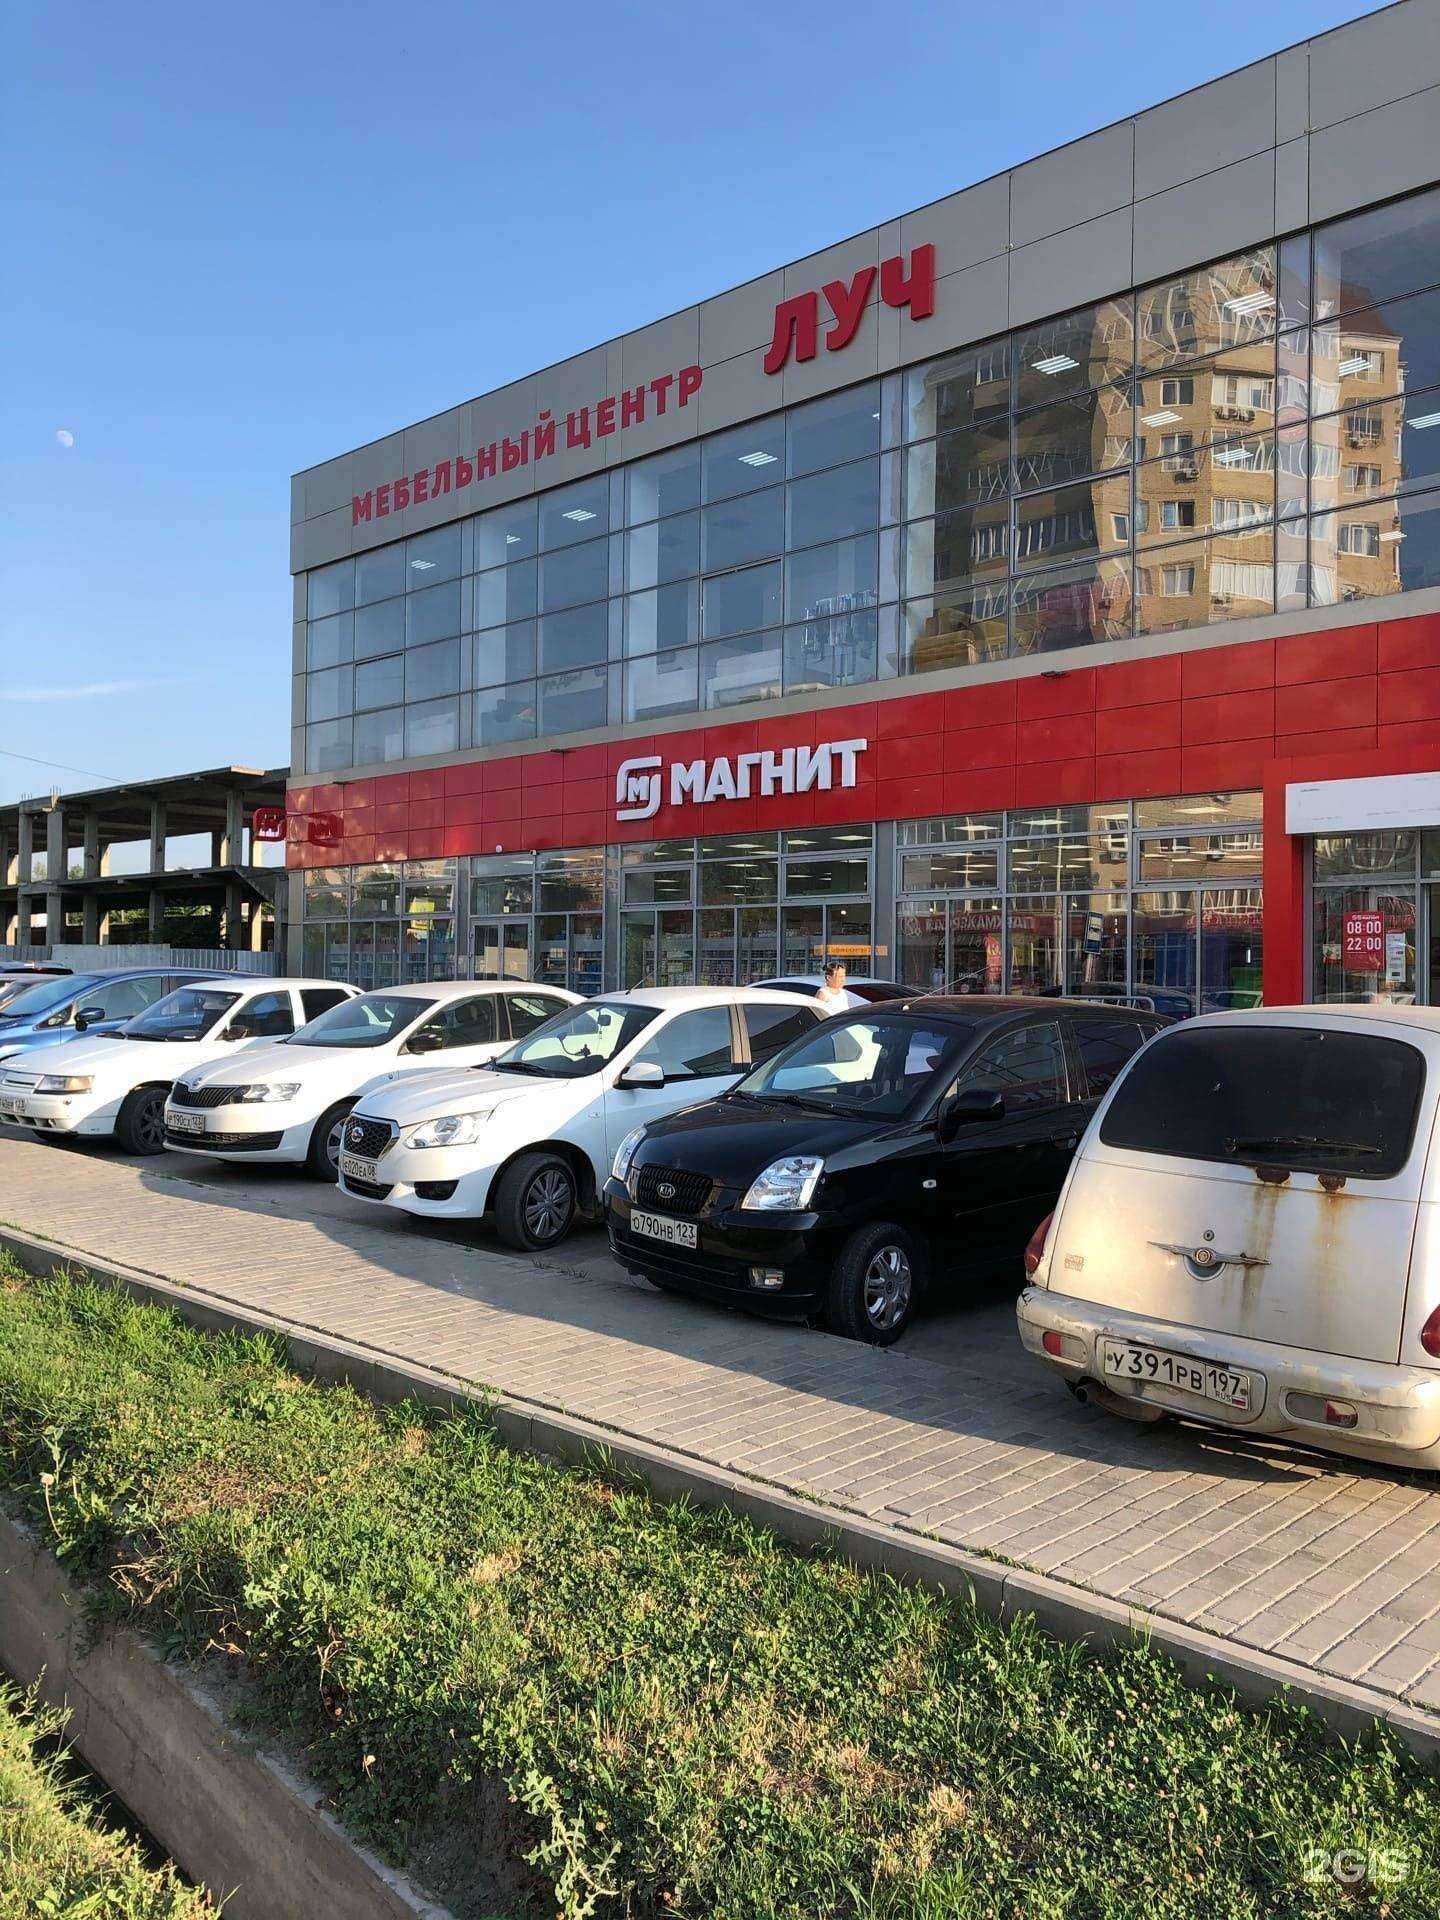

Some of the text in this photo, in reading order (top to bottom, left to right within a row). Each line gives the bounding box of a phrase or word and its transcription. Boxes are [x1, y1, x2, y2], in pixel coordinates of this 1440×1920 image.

[763, 243, 935, 375] ЛУЧ
[351, 364, 703, 526] МЕБЕЛЬНЫЙ ЦЕНТР
[670, 738, 868, 806] МАГНИТ
[1346, 921, 1382, 934] 08:00
[1346, 937, 1382, 950] 22:00
[1208, 1369, 1241, 1396] 197
